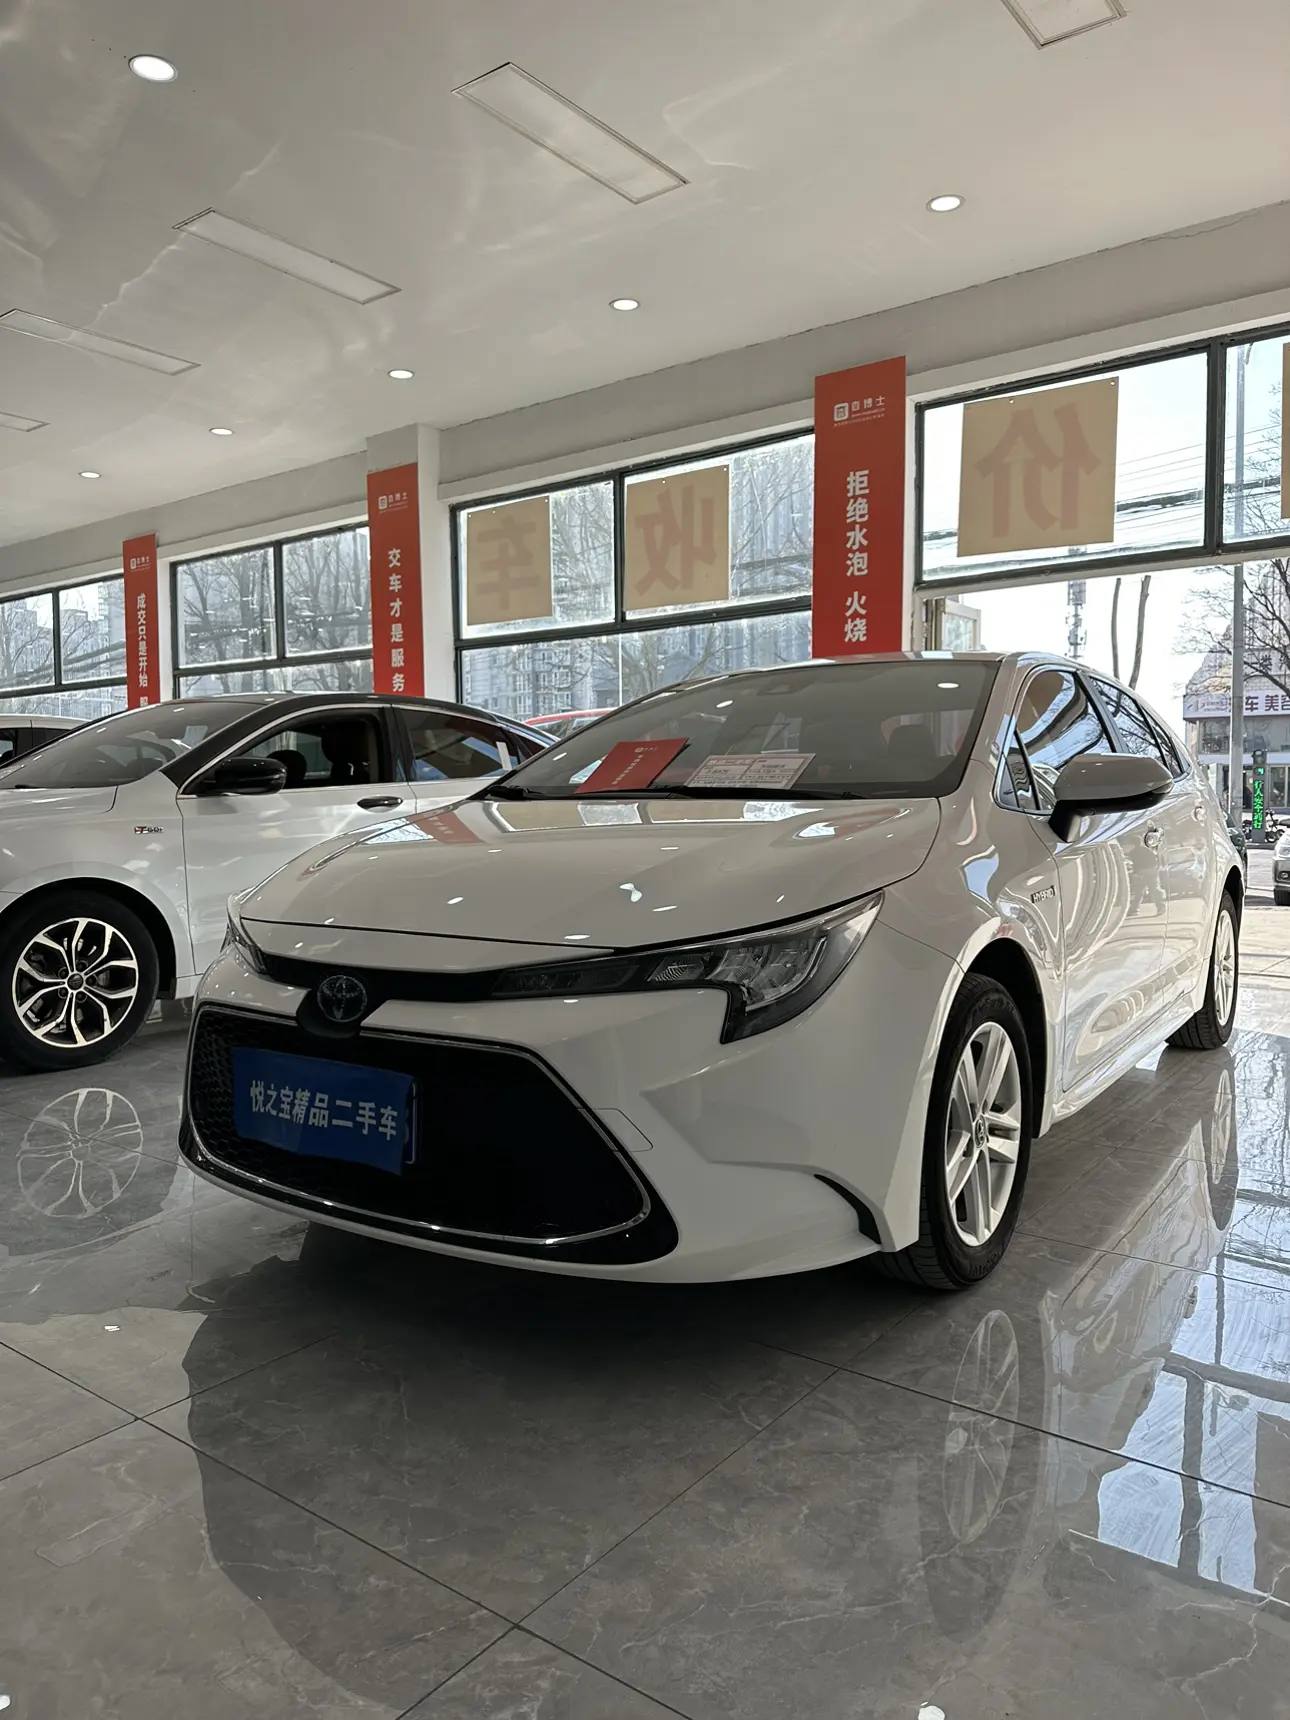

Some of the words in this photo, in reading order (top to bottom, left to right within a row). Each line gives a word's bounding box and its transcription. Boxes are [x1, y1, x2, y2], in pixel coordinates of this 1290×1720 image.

[846, 469, 869, 577] 拒绝水泡
[137, 593, 148, 687] 成交只是开始
[388, 548, 405, 692] 交车才是服务
[844, 591, 867, 643] 火烧
[250, 1080, 398, 1140] 悦之宝精品二手车
